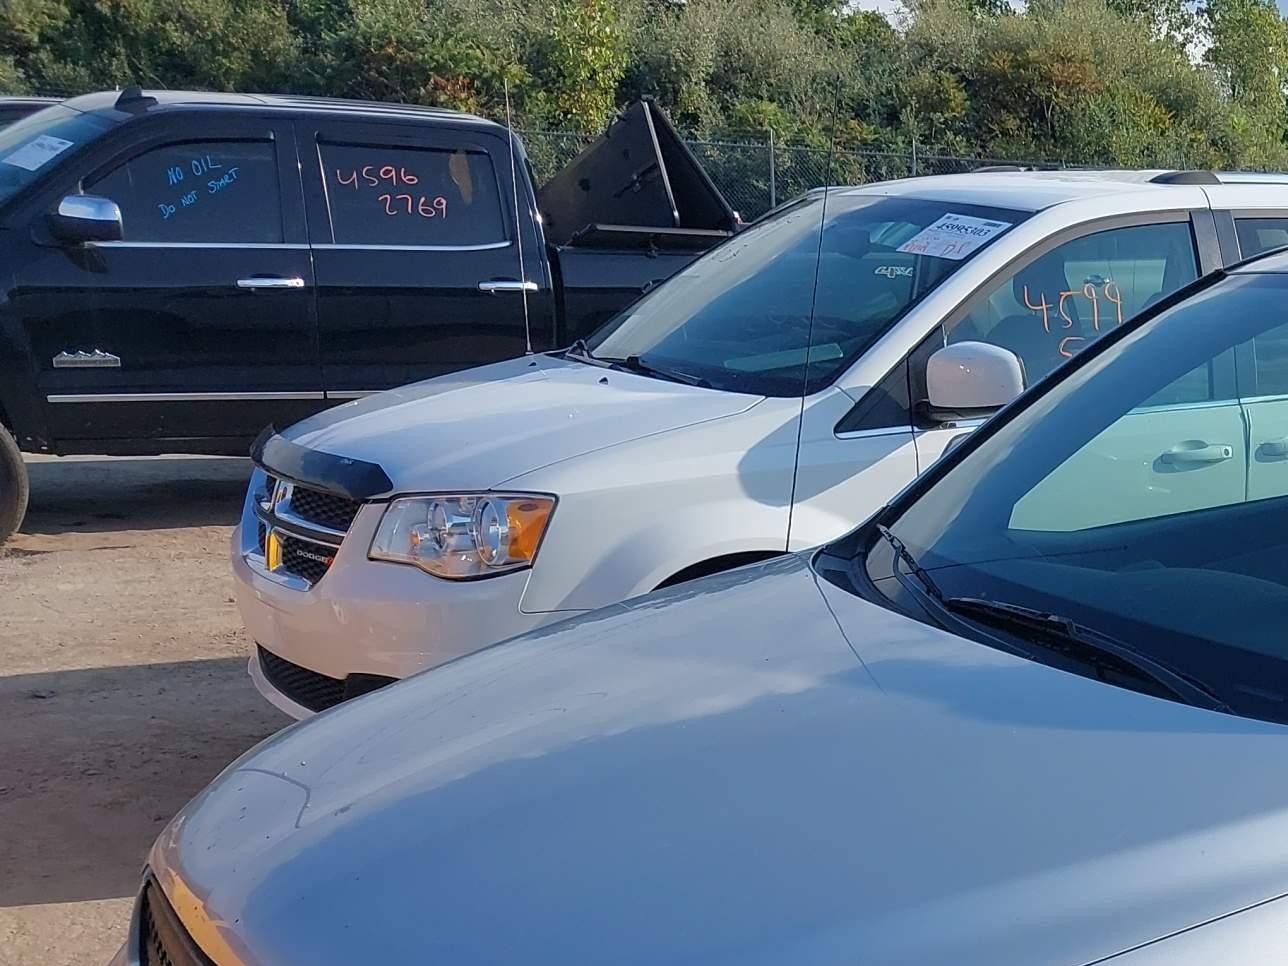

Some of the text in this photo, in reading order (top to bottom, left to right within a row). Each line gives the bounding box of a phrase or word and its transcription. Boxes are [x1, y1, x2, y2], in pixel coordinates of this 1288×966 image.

[167, 155, 222, 185] NO OIL
[336, 166, 419, 191] 4596
[181, 190, 198, 207] NOT
[207, 167, 240, 193] START
[378, 194, 447, 219] 2769
[1023, 283, 1122, 333] 4599
